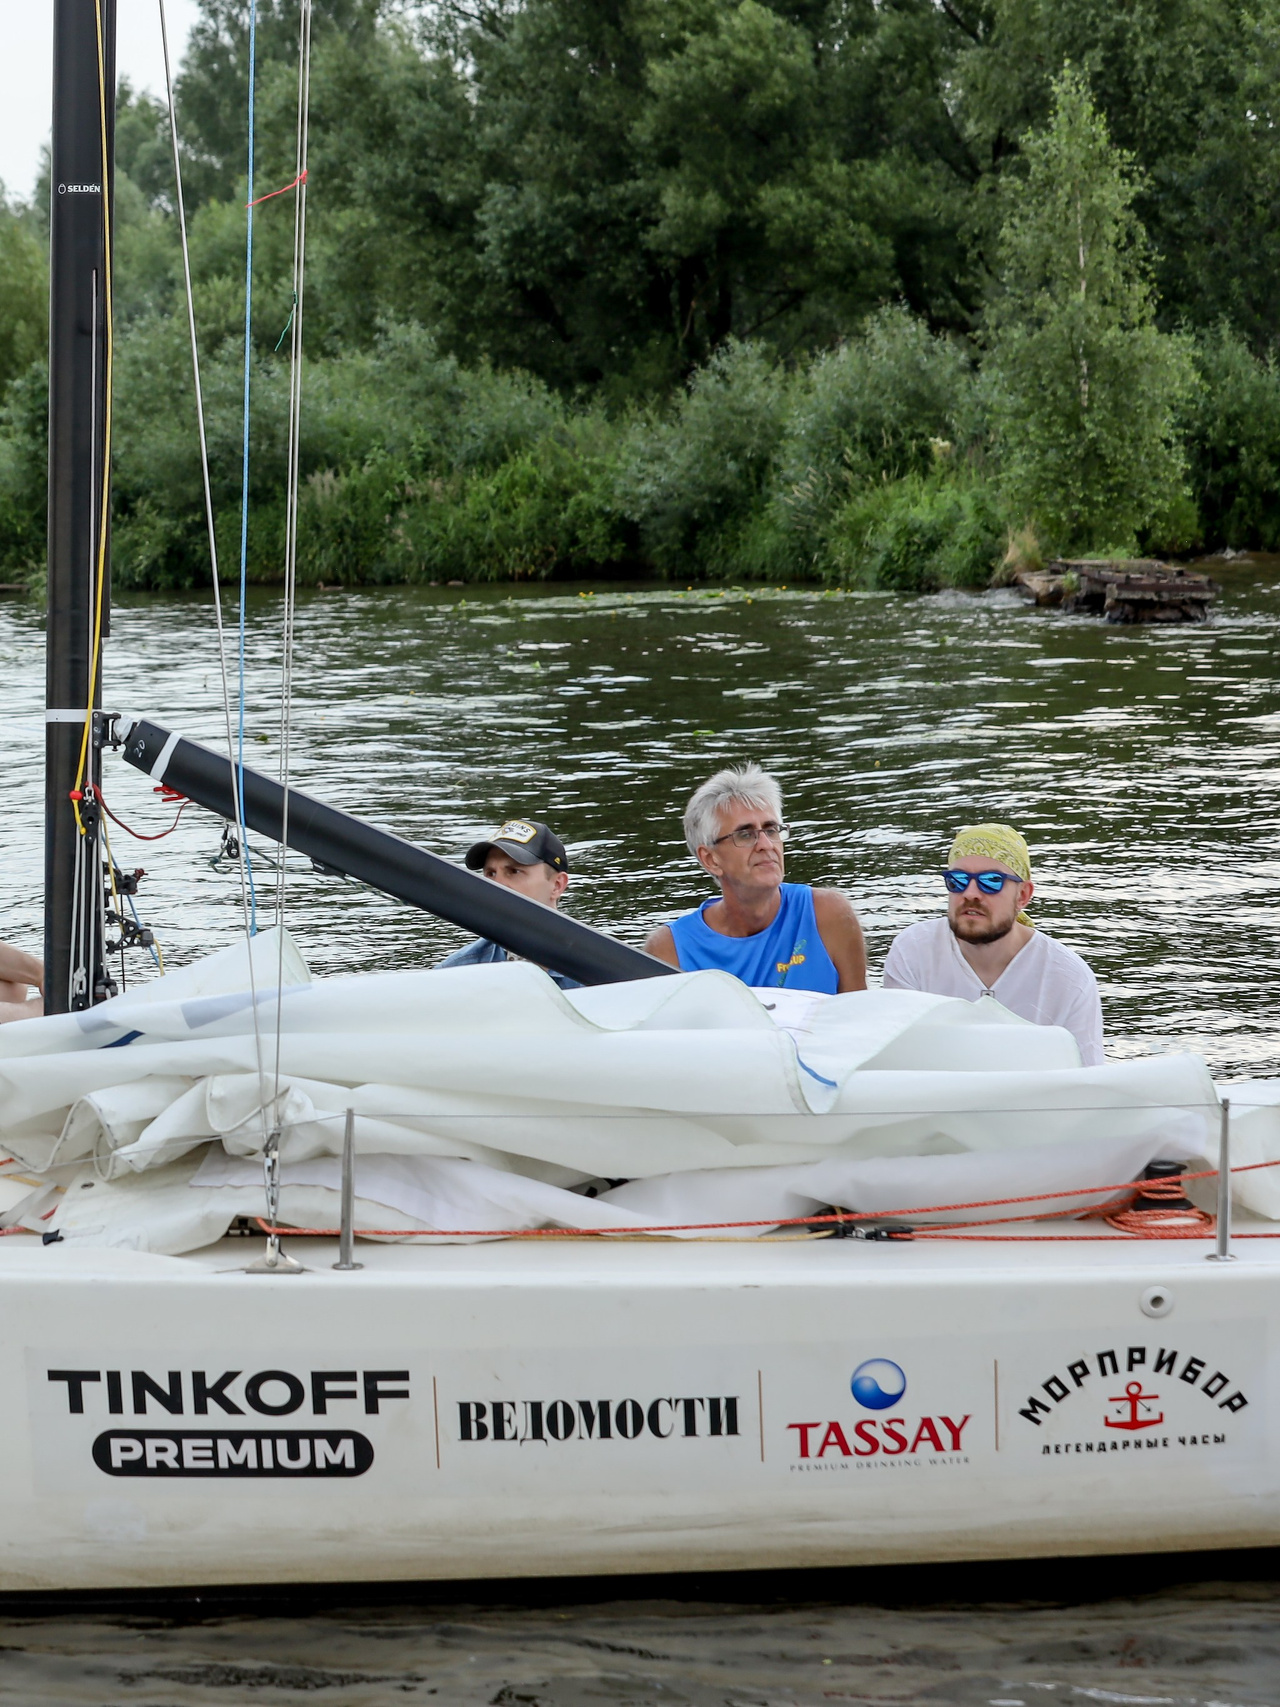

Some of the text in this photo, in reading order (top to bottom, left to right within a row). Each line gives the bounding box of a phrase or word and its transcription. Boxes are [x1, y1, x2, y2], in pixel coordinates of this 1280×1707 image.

[67, 184, 101, 193] SELDÉN
[47, 1369, 410, 1417] TINKOFF
[1018, 1346, 1250, 1427] МОРПРИБОР
[457, 1396, 742, 1448] ВЕДОМОСТИ
[786, 1413, 973, 1459] TASSAY
[109, 1437, 356, 1470] PREMIUM
[1041, 1433, 1227, 1455] ЛЕГЕНДАРНЫЕ ЧАСЫ
[789, 1456, 971, 1473] PREMIUM DRINKING WATER
